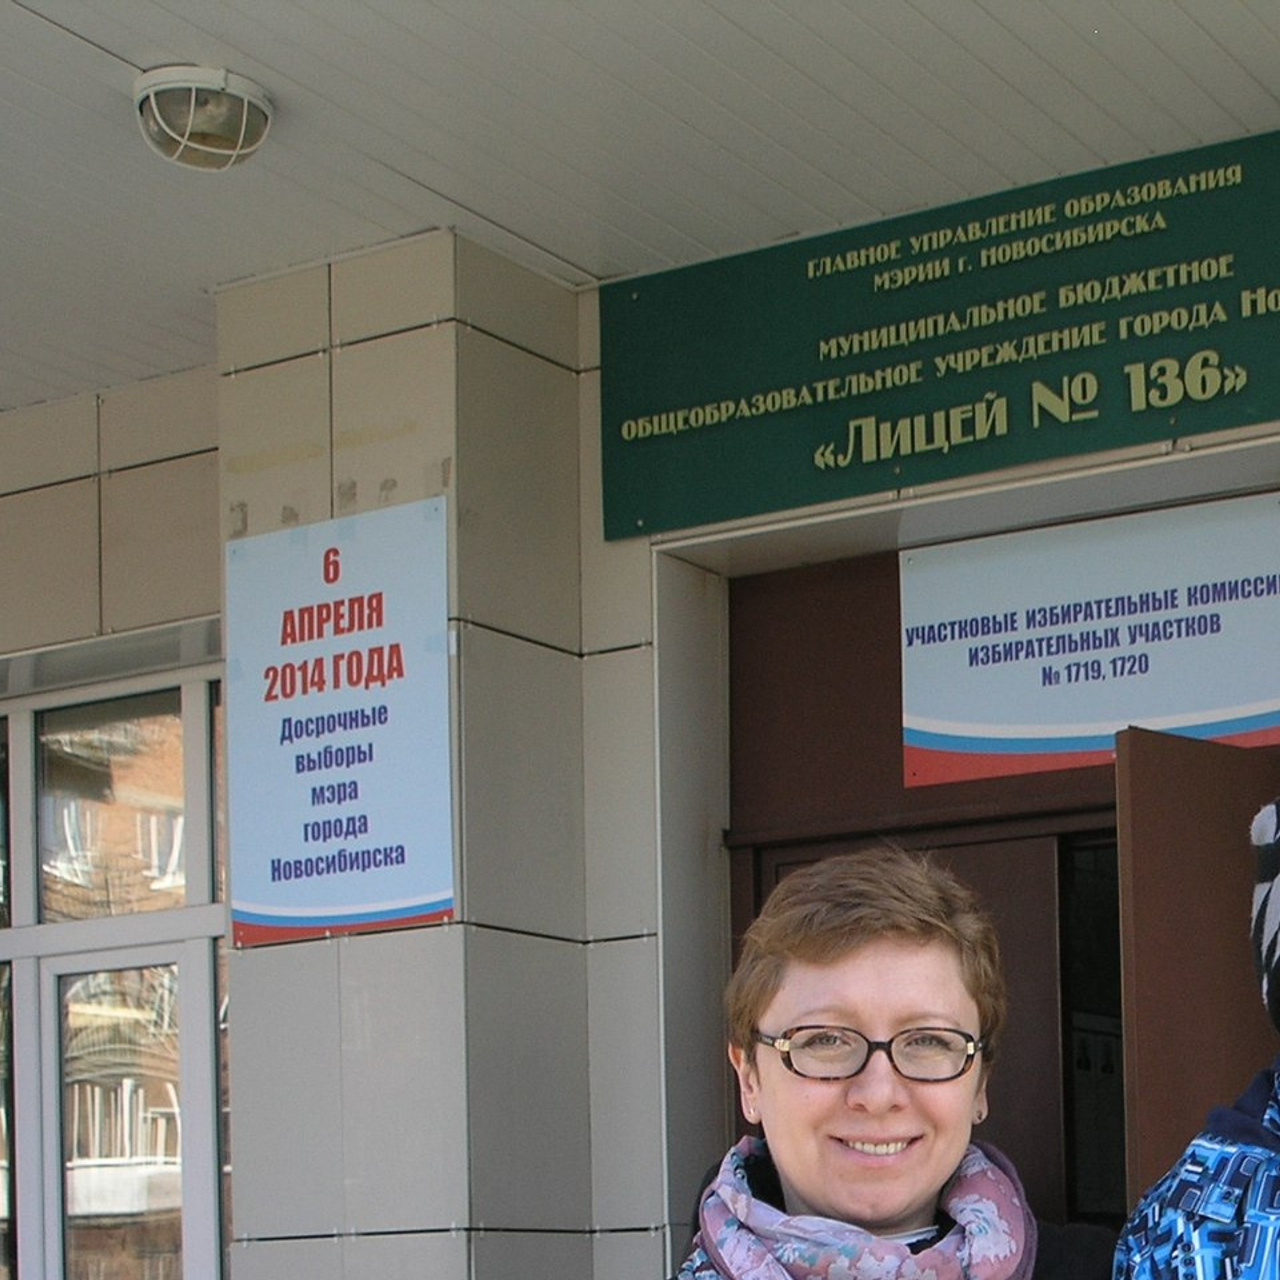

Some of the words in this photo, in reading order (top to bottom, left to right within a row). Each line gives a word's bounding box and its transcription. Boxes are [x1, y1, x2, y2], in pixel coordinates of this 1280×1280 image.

[807, 240, 901, 279] ГЛАВНОЕ
[909, 202, 1056, 257] УПРАВЛЕНИЕ
[1064, 164, 1243, 220] ОБРАЗОВАНИЯ
[874, 260, 951, 293] МЭРИИ
[958, 256, 973, 274] г.
[819, 290, 1048, 361] МУНИЦИПАЛЬНОЕ
[1057, 253, 1235, 310] БЮДЖЕТНОЕ
[620, 360, 923, 441] ОБЩЕОБРАЗОВАТЕЛЬНОЕ
[935, 320, 1107, 378] УЧРЕЖДЕНИЕ
[1118, 299, 1228, 341] ГОРОДА
[813, 390, 1010, 471] «ЛИЦЕЙ
[1031, 370, 1099, 430] №
[1123, 349, 1248, 413] 136»
[322, 546, 341, 585] 6
[280, 591, 384, 647] АПРЕЛЯ
[905, 609, 1019, 648] УЧАСТКОВЫЕ
[1025, 586, 1179, 632] ИЗБИРАТЕЛЬНЫЕ
[968, 627, 1120, 668] ИЗБИРАТЕЛЬНЫХ
[1127, 612, 1222, 647] УЧАСТКОВ
[263, 656, 327, 702] 2014
[332, 643, 405, 692] ГОДА
[1041, 663, 1061, 688] №
[1064, 658, 1106, 682] 1719,
[1111, 652, 1150, 677] 1720
[279, 704, 389, 746] Досрочные
[295, 741, 374, 775] выборы
[311, 779, 359, 808] мэра
[303, 814, 369, 843] города
[270, 844, 406, 883] Новосибирска
